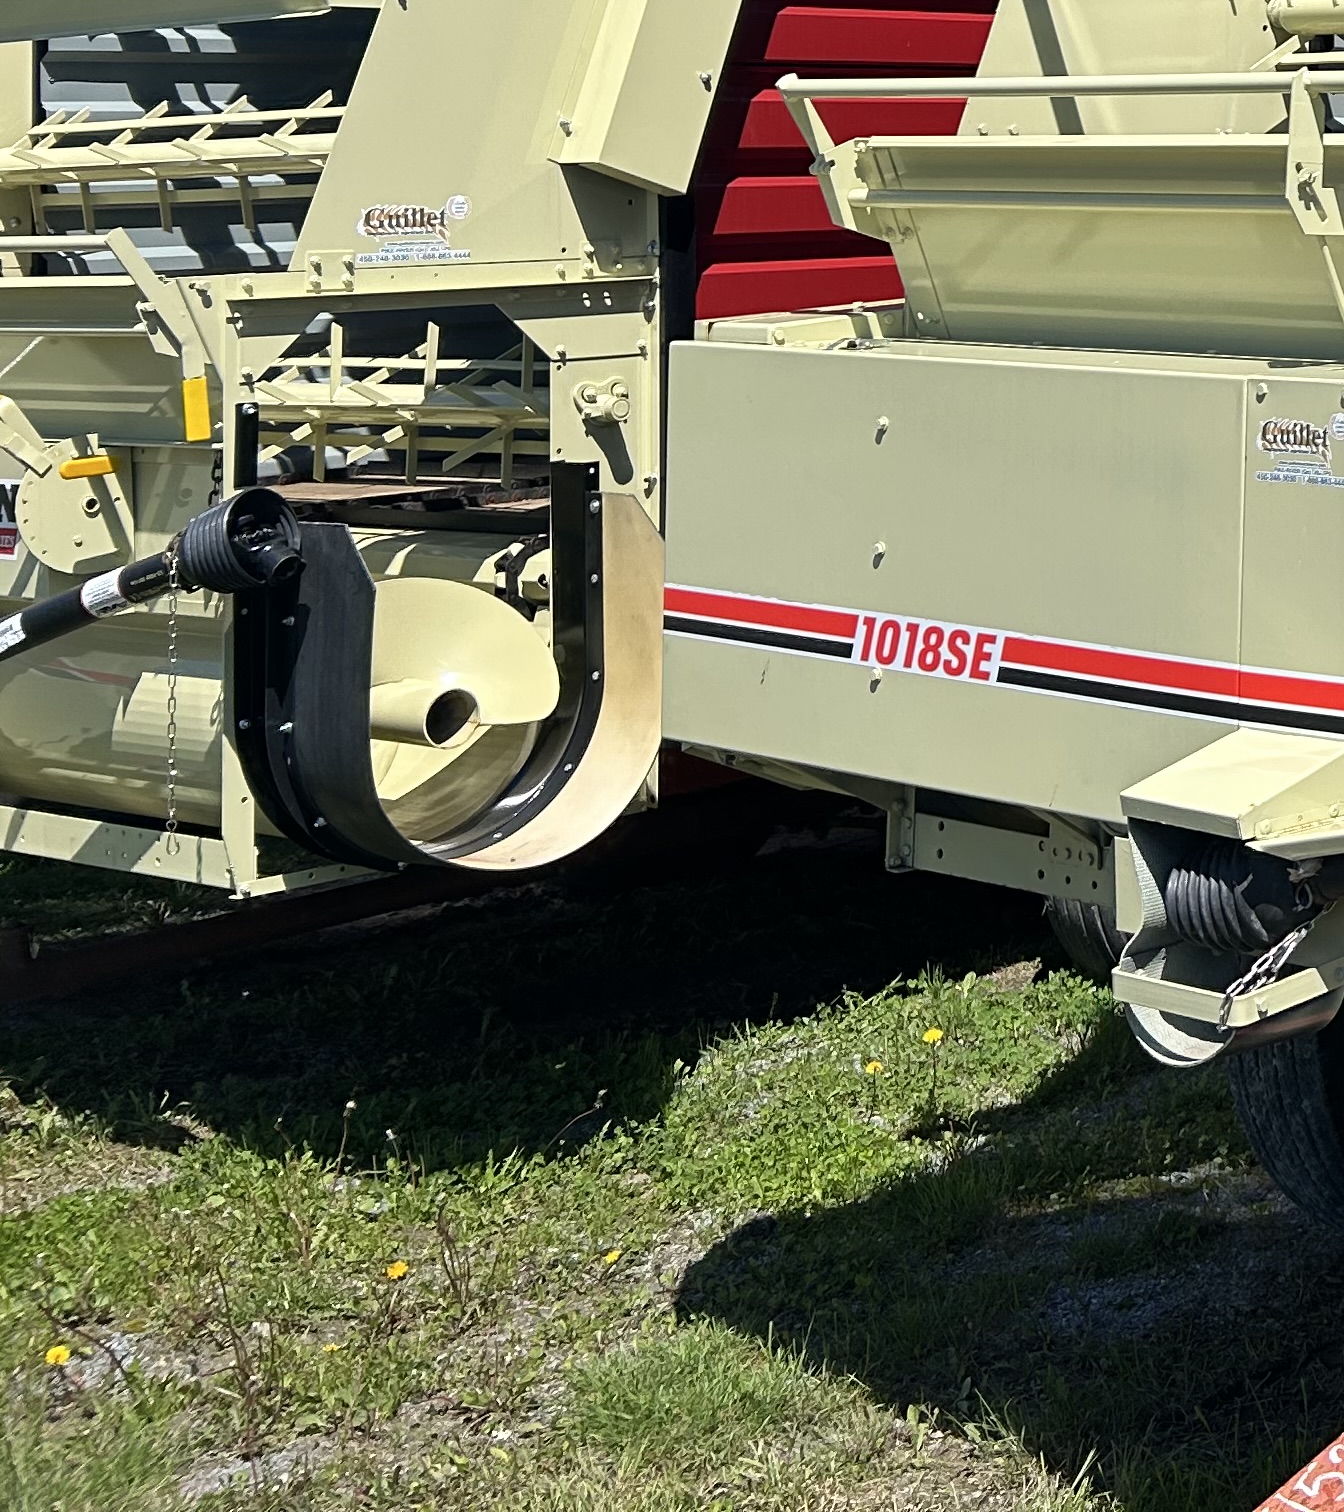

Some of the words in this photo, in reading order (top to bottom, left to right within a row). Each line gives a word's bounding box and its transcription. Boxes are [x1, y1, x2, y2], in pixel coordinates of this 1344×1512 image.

[363, 207, 448, 229] Guillet
[1261, 420, 1329, 447] Guillet
[860, 615, 997, 681] 1018SE
